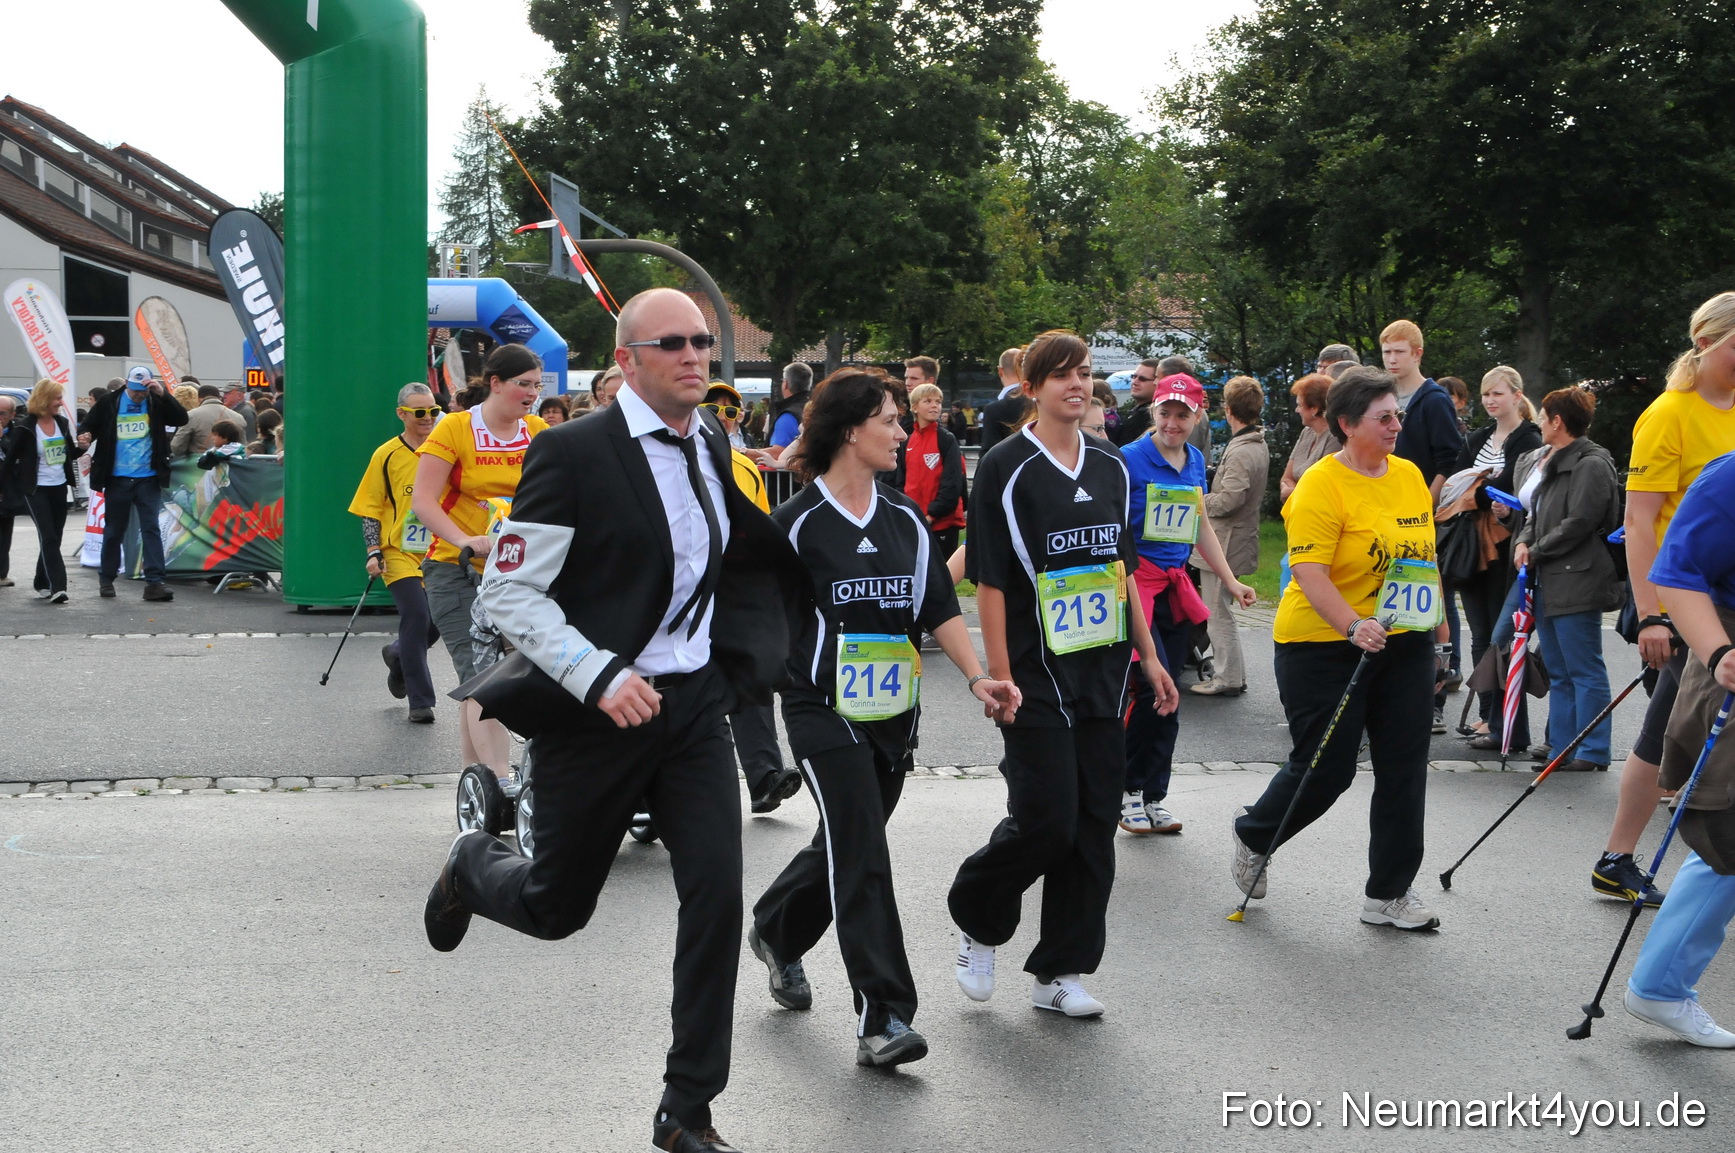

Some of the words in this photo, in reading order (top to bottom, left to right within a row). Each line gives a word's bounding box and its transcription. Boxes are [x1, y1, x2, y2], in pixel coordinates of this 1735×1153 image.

[427, 304, 440, 315] uf
[117, 422, 145, 433] 1120
[475, 456, 503, 466] MAX
[507, 453, 524, 466] BÖ
[1152, 504, 1191, 527] 117
[1396, 516, 1420, 526] swn
[406, 525, 427, 542] 21
[1051, 527, 1115, 550] ONLINE
[837, 578, 908, 600] ONLINE
[1383, 581, 1432, 613] 210
[1051, 592, 1108, 633] 213
[1063, 630, 1086, 640] Nadine
[841, 663, 902, 698] 214
[850, 700, 876, 708] Corinna
